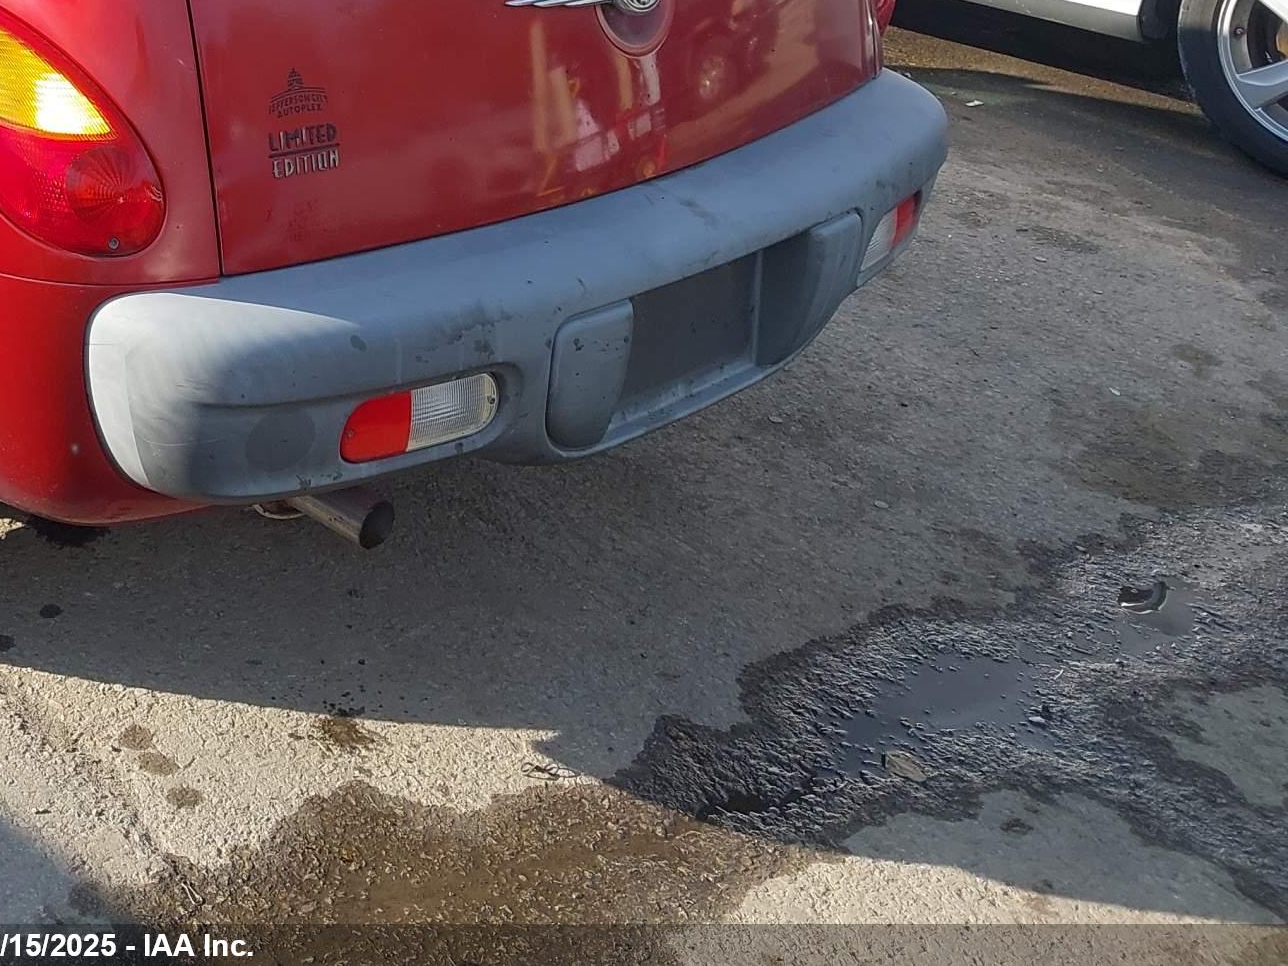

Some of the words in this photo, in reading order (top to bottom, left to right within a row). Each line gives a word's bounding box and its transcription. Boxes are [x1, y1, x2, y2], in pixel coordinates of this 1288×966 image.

[268, 94, 311, 114] JEFFERSON
[277, 103, 323, 119] AUTOPLEX
[268, 123, 337, 151] LIMITED
[272, 150, 339, 179] EDITION
